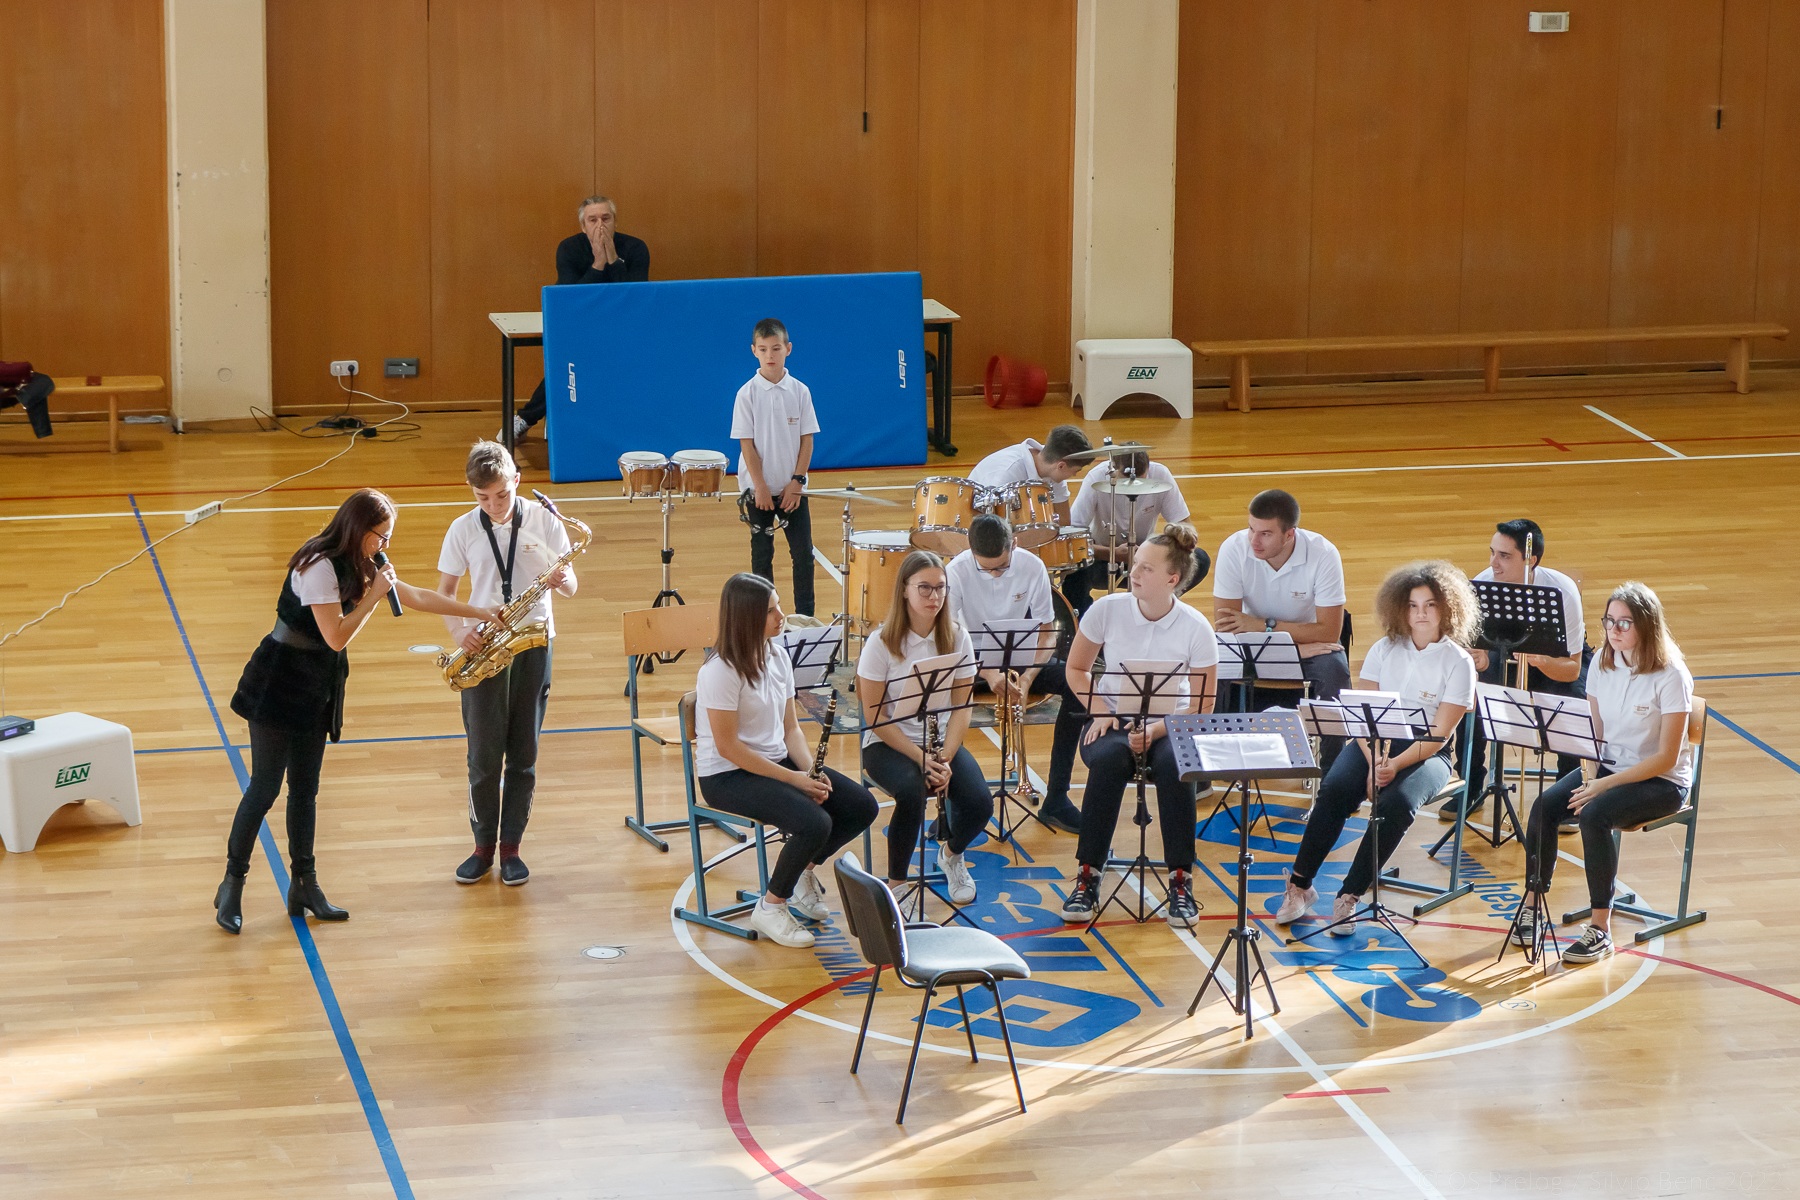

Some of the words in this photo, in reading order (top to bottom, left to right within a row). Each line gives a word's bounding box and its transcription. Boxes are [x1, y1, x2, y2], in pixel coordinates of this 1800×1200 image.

[567, 362, 577, 403] elan
[898, 349, 907, 389] elan
[1127, 368, 1158, 379] ELAN
[55, 764, 91, 786] ELAN
